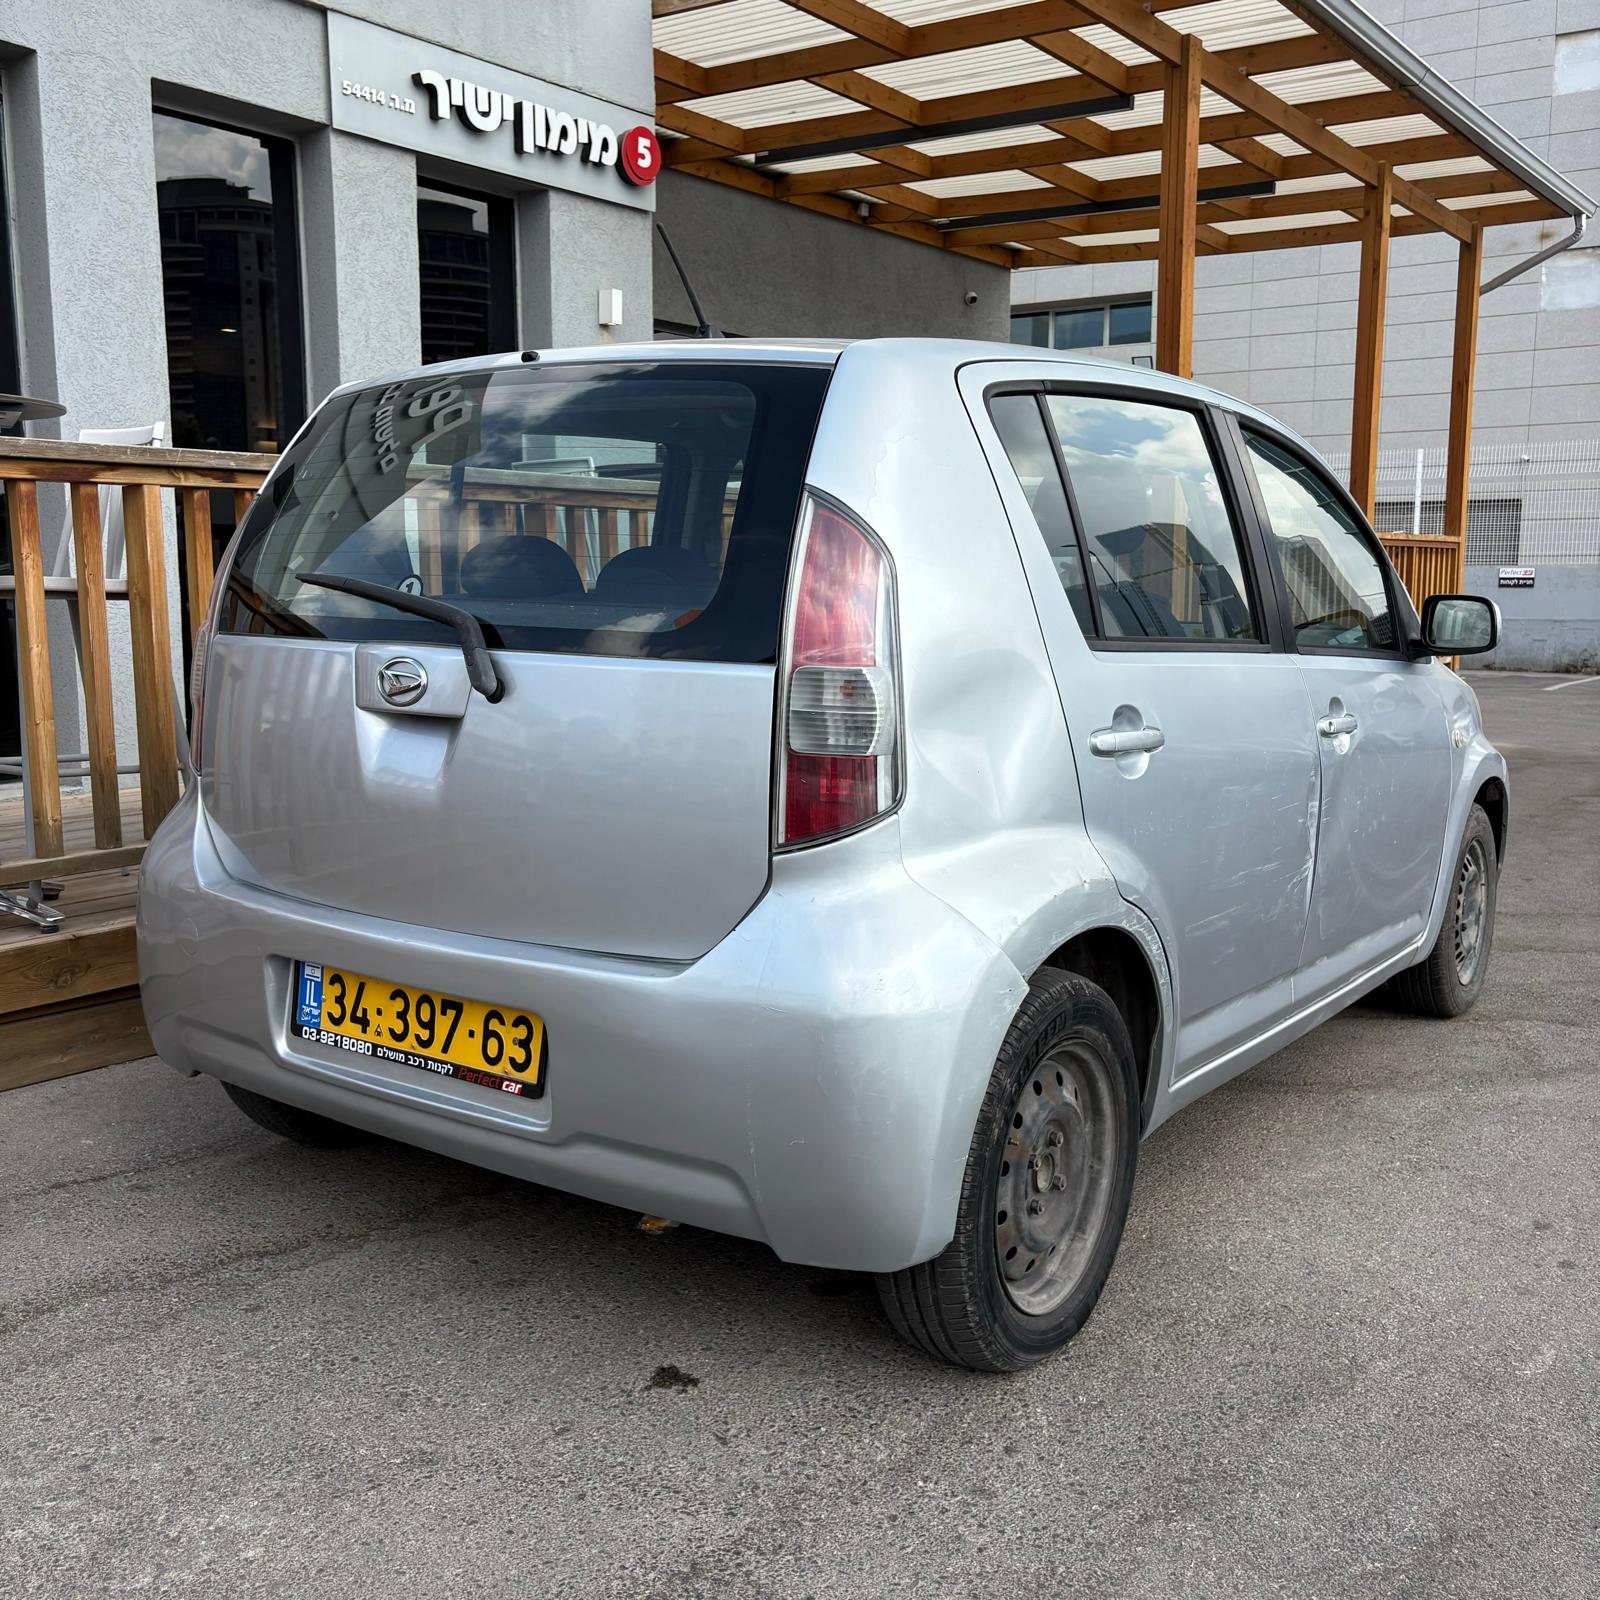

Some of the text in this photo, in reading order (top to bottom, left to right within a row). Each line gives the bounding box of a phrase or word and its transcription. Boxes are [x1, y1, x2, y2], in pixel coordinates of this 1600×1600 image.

[341, 79, 386, 106] 54414
[412, 69, 651, 168] 5 מימון ישיר
[305, 980, 318, 1006] IL
[302, 1026, 372, 1056] 03-9218080
[377, 1046, 454, 1075] לקנות רכב מושלם
[458, 1067, 522, 1094] Perfect car
